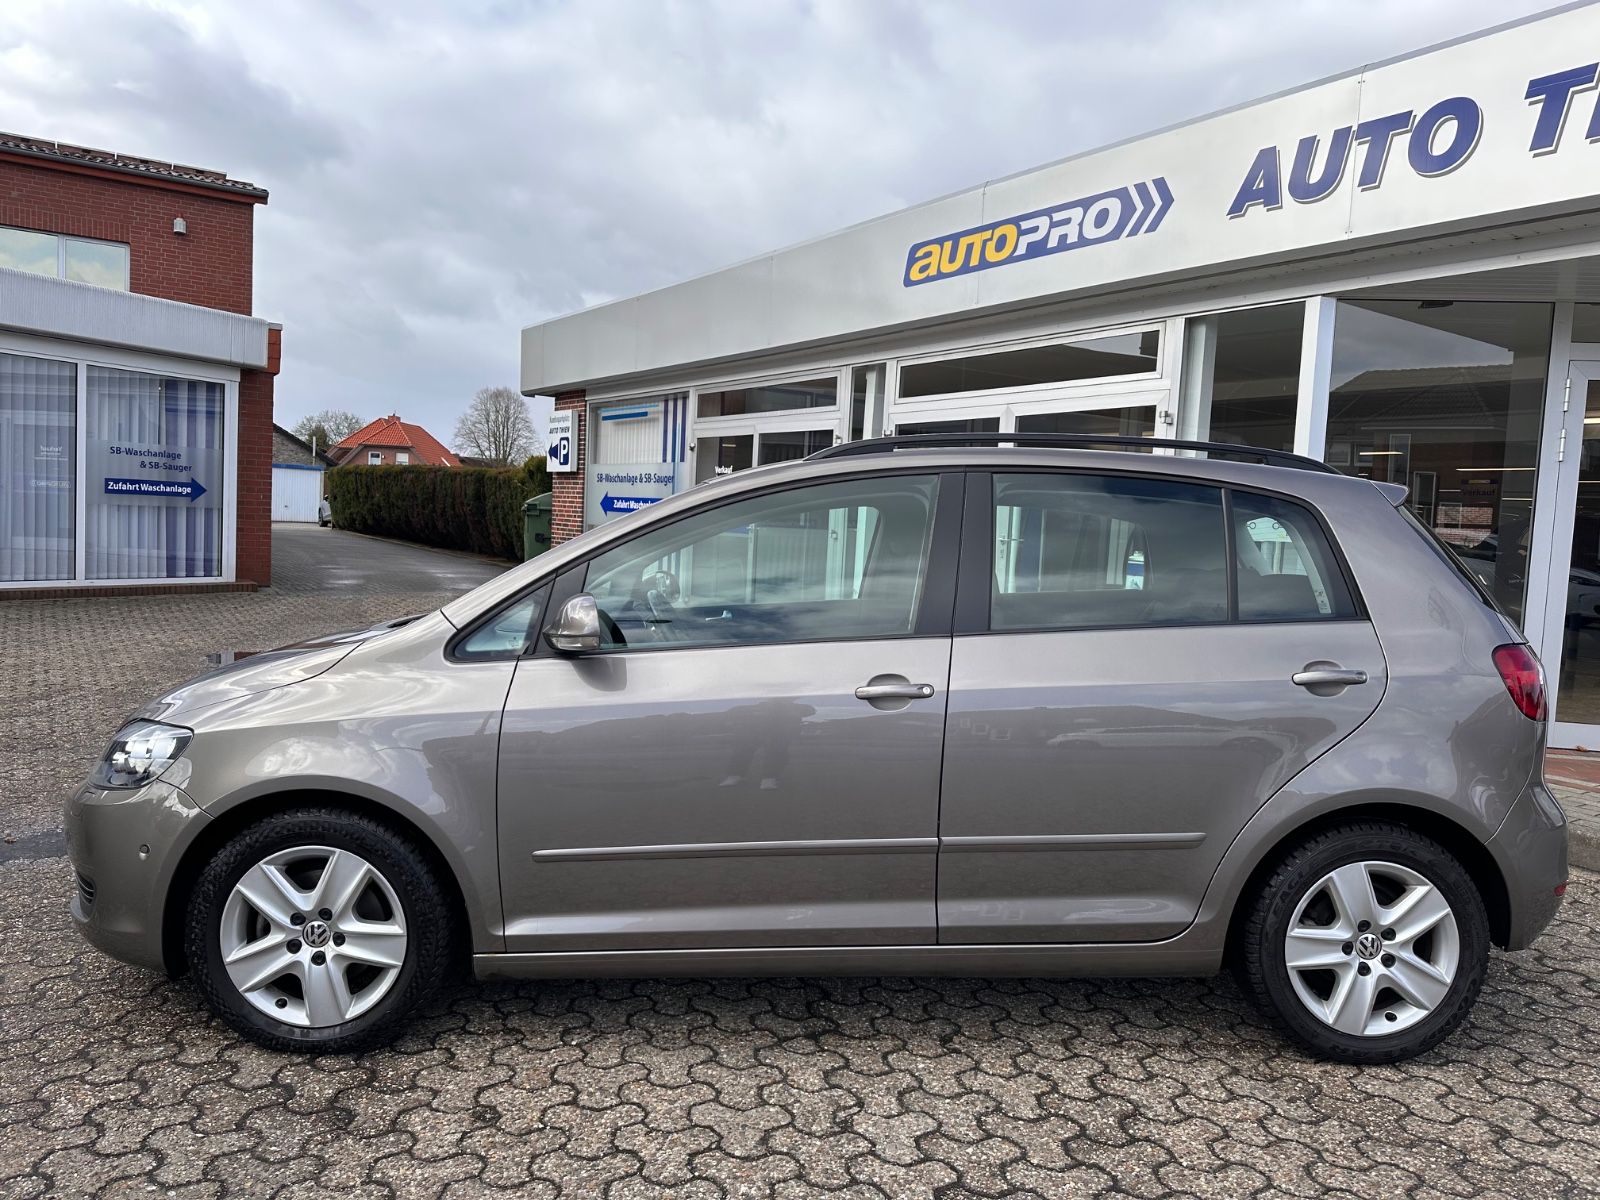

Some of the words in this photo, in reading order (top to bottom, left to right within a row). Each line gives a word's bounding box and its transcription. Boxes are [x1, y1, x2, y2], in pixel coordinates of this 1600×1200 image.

[1226, 96, 1484, 220] AUTO
[110, 446, 182, 461] SB-Waschanlage
[560, 439, 569, 463] P
[139, 461, 147, 469] &
[148, 461, 192, 472] SB-Sauger
[597, 473, 638, 486] SB-Waschanlage
[639, 473, 644, 484] &
[644, 473, 674, 486] SB-Sauger
[107, 482, 140, 491] Zufahrt
[140, 483, 192, 495] Waschanlage
[613, 499, 630, 509] Zufahrt
